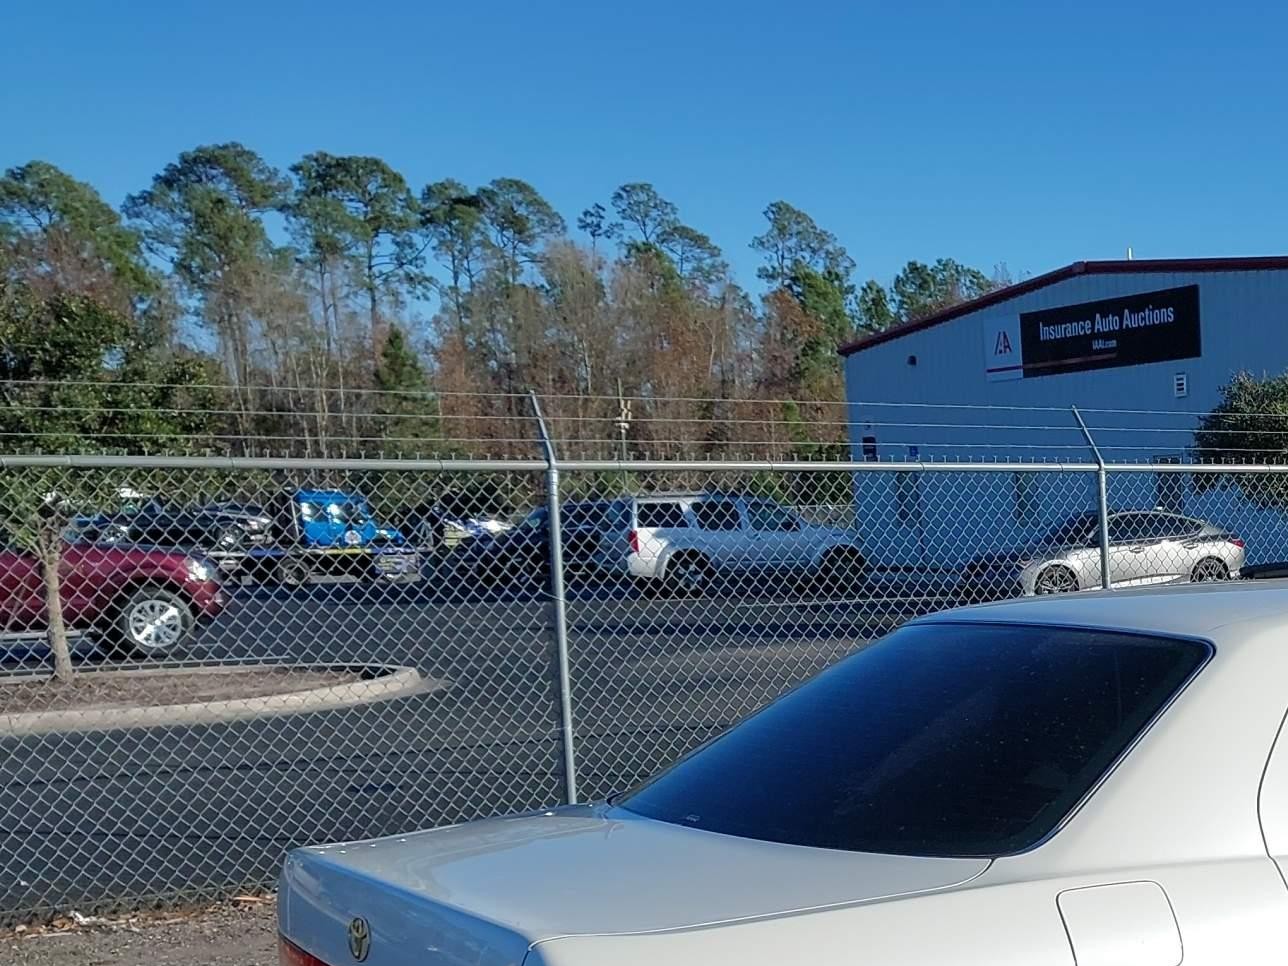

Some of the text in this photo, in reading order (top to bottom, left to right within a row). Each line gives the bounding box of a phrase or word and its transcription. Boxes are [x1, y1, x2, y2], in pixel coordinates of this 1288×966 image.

[1039, 304, 1174, 341] Insurance Auto Auctions
